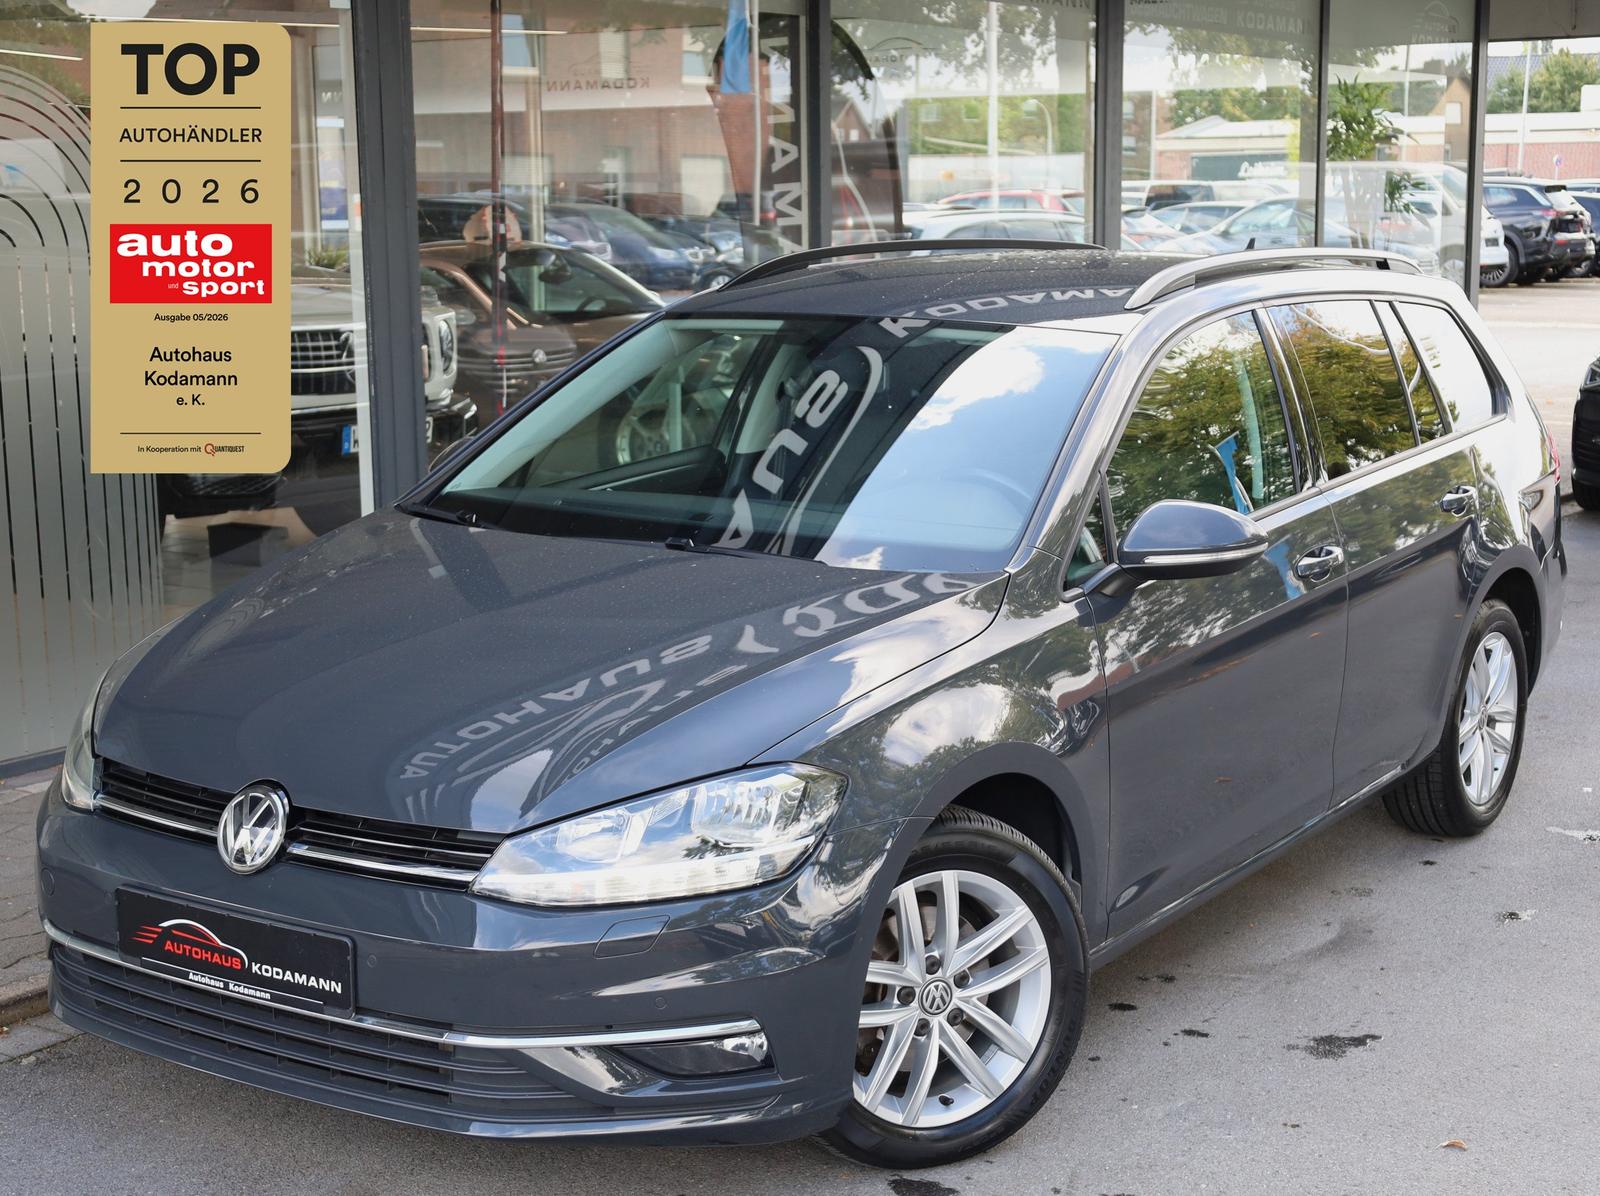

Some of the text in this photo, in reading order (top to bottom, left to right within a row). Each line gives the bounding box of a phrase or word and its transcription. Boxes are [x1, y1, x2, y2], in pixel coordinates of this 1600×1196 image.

[164, 940, 342, 994] AUTOHAUS KODAMANN
[188, 972, 271, 1000] Autohaus Kodamann
